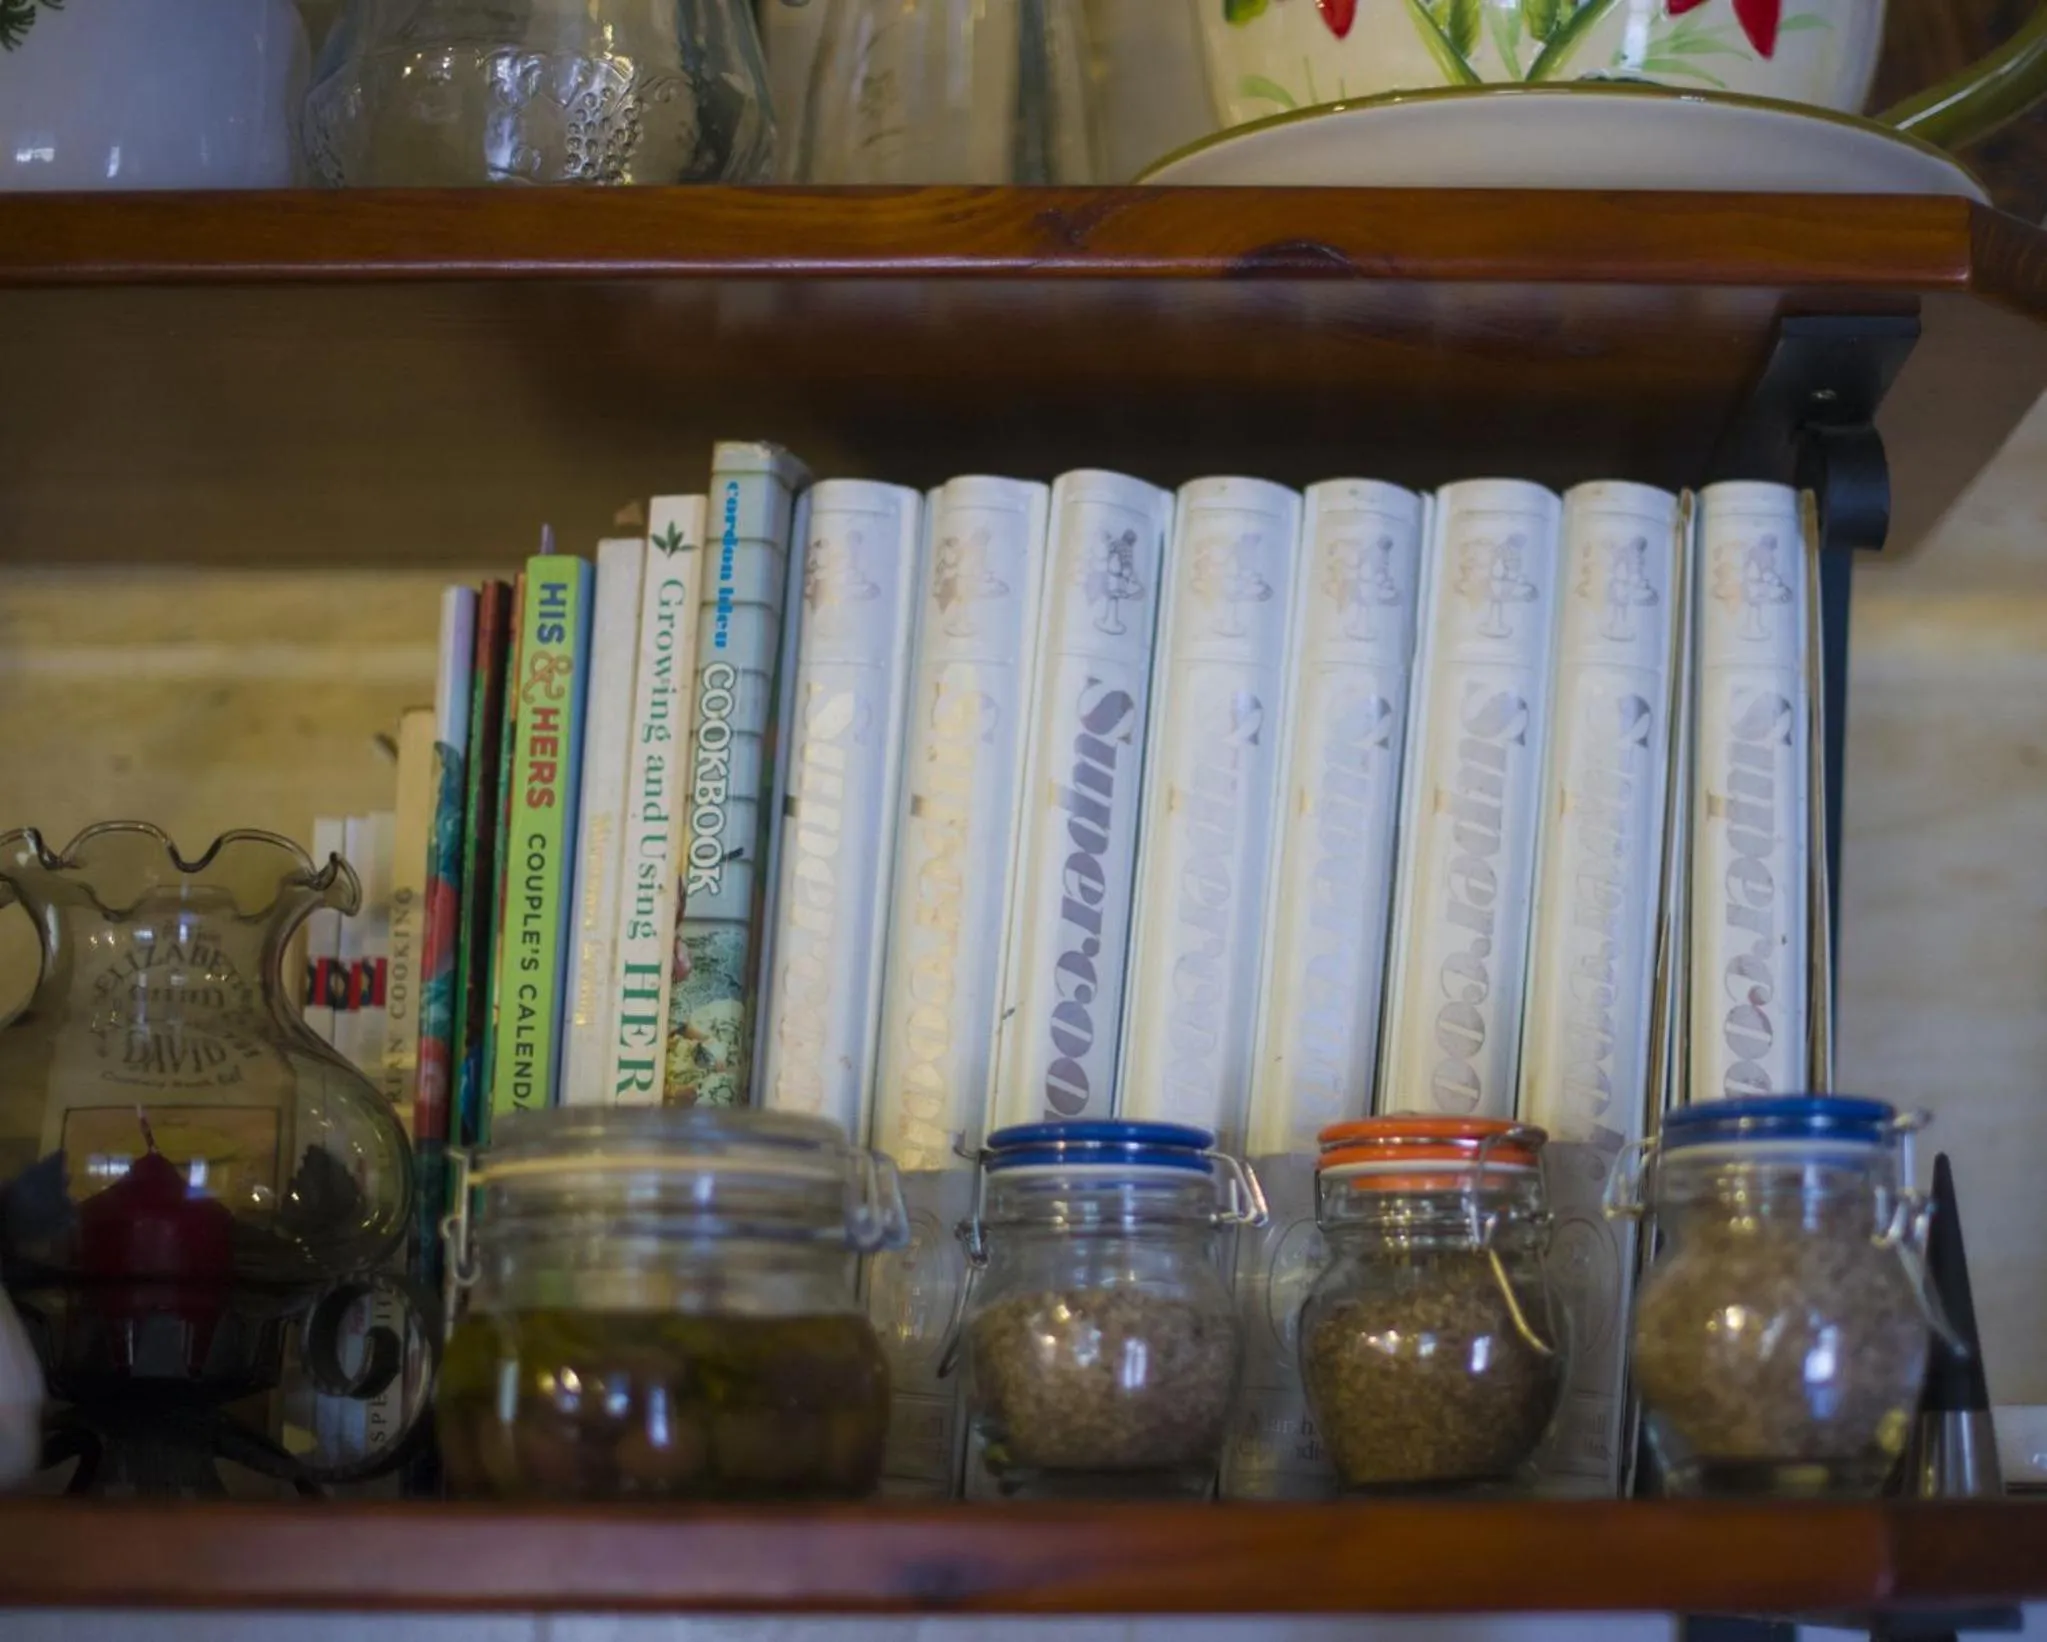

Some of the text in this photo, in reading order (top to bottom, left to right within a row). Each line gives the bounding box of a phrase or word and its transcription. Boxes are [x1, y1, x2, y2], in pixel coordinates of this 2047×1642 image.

[536, 582, 568, 645] HIS
[714, 482, 739, 649] cordon bleu
[521, 651, 573, 703] &
[526, 707, 560, 810] HERS
[688, 664, 735, 899] COOKBOOK
[519, 833, 547, 972] COUPLE'S
[614, 578, 687, 1095] Growing and Using HER
[1044, 678, 1133, 1119] Supercoo
[391, 888, 412, 1018] COOKING
[123, 1031, 228, 1073] DAVID
